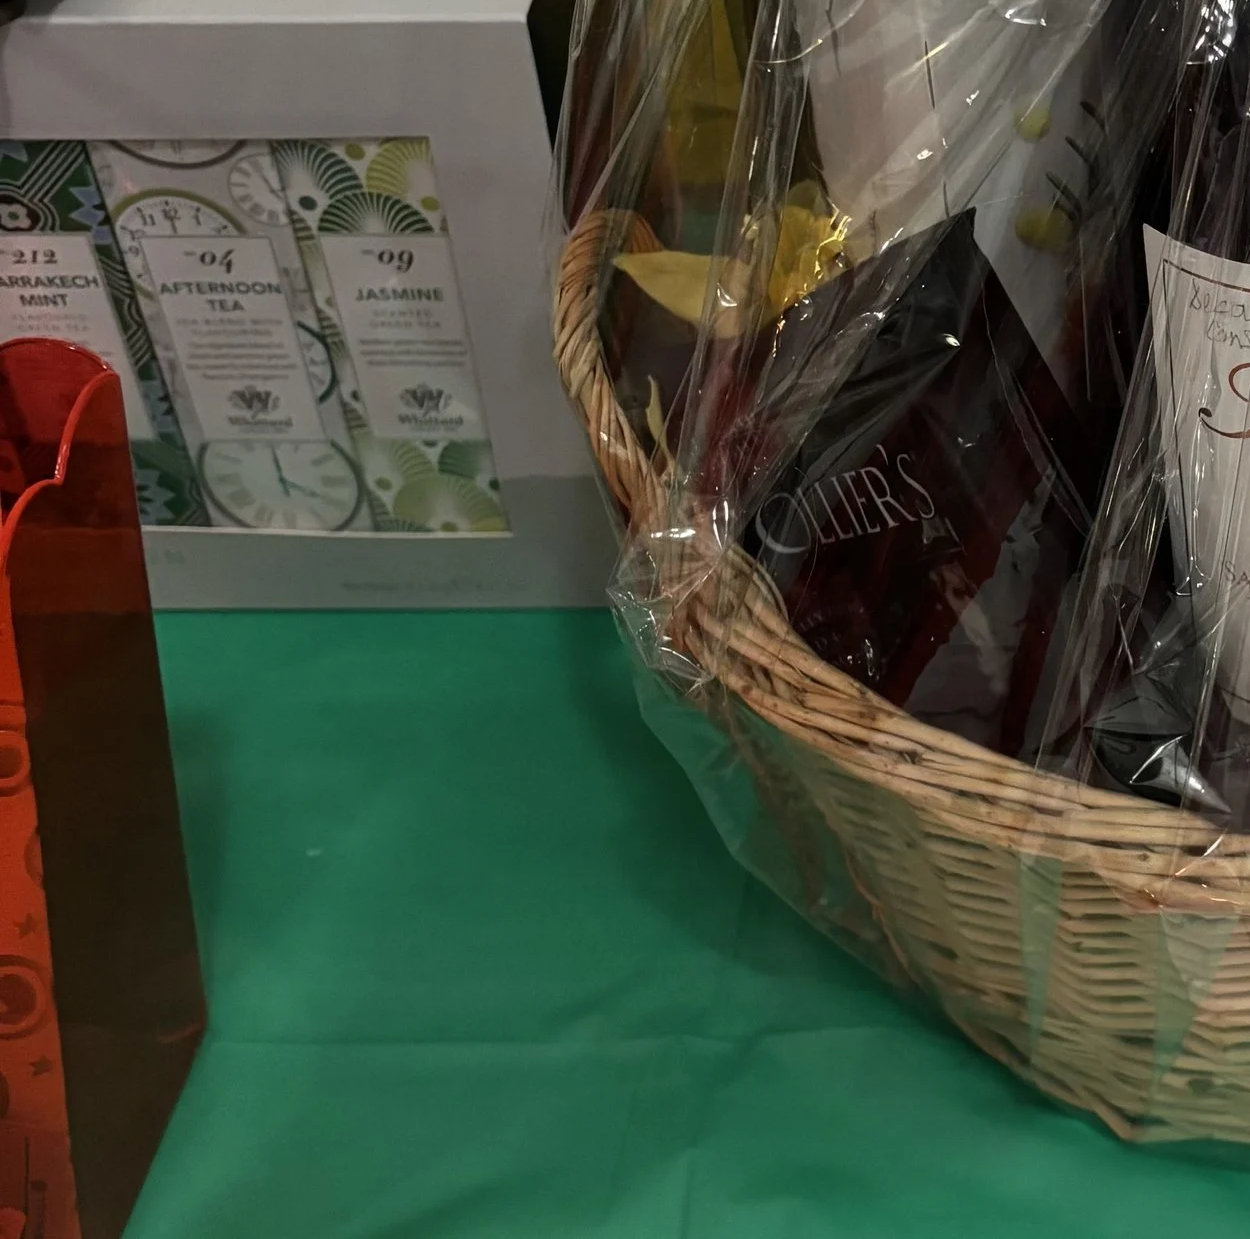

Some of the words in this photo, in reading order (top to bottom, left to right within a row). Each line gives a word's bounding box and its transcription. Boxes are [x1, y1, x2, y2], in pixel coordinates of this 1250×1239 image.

[160, 280, 283, 295] AFTERNOON
[355, 287, 445, 302] JASMINE
[19, 293, 69, 307] MINT
[206, 299, 246, 311] TEA
